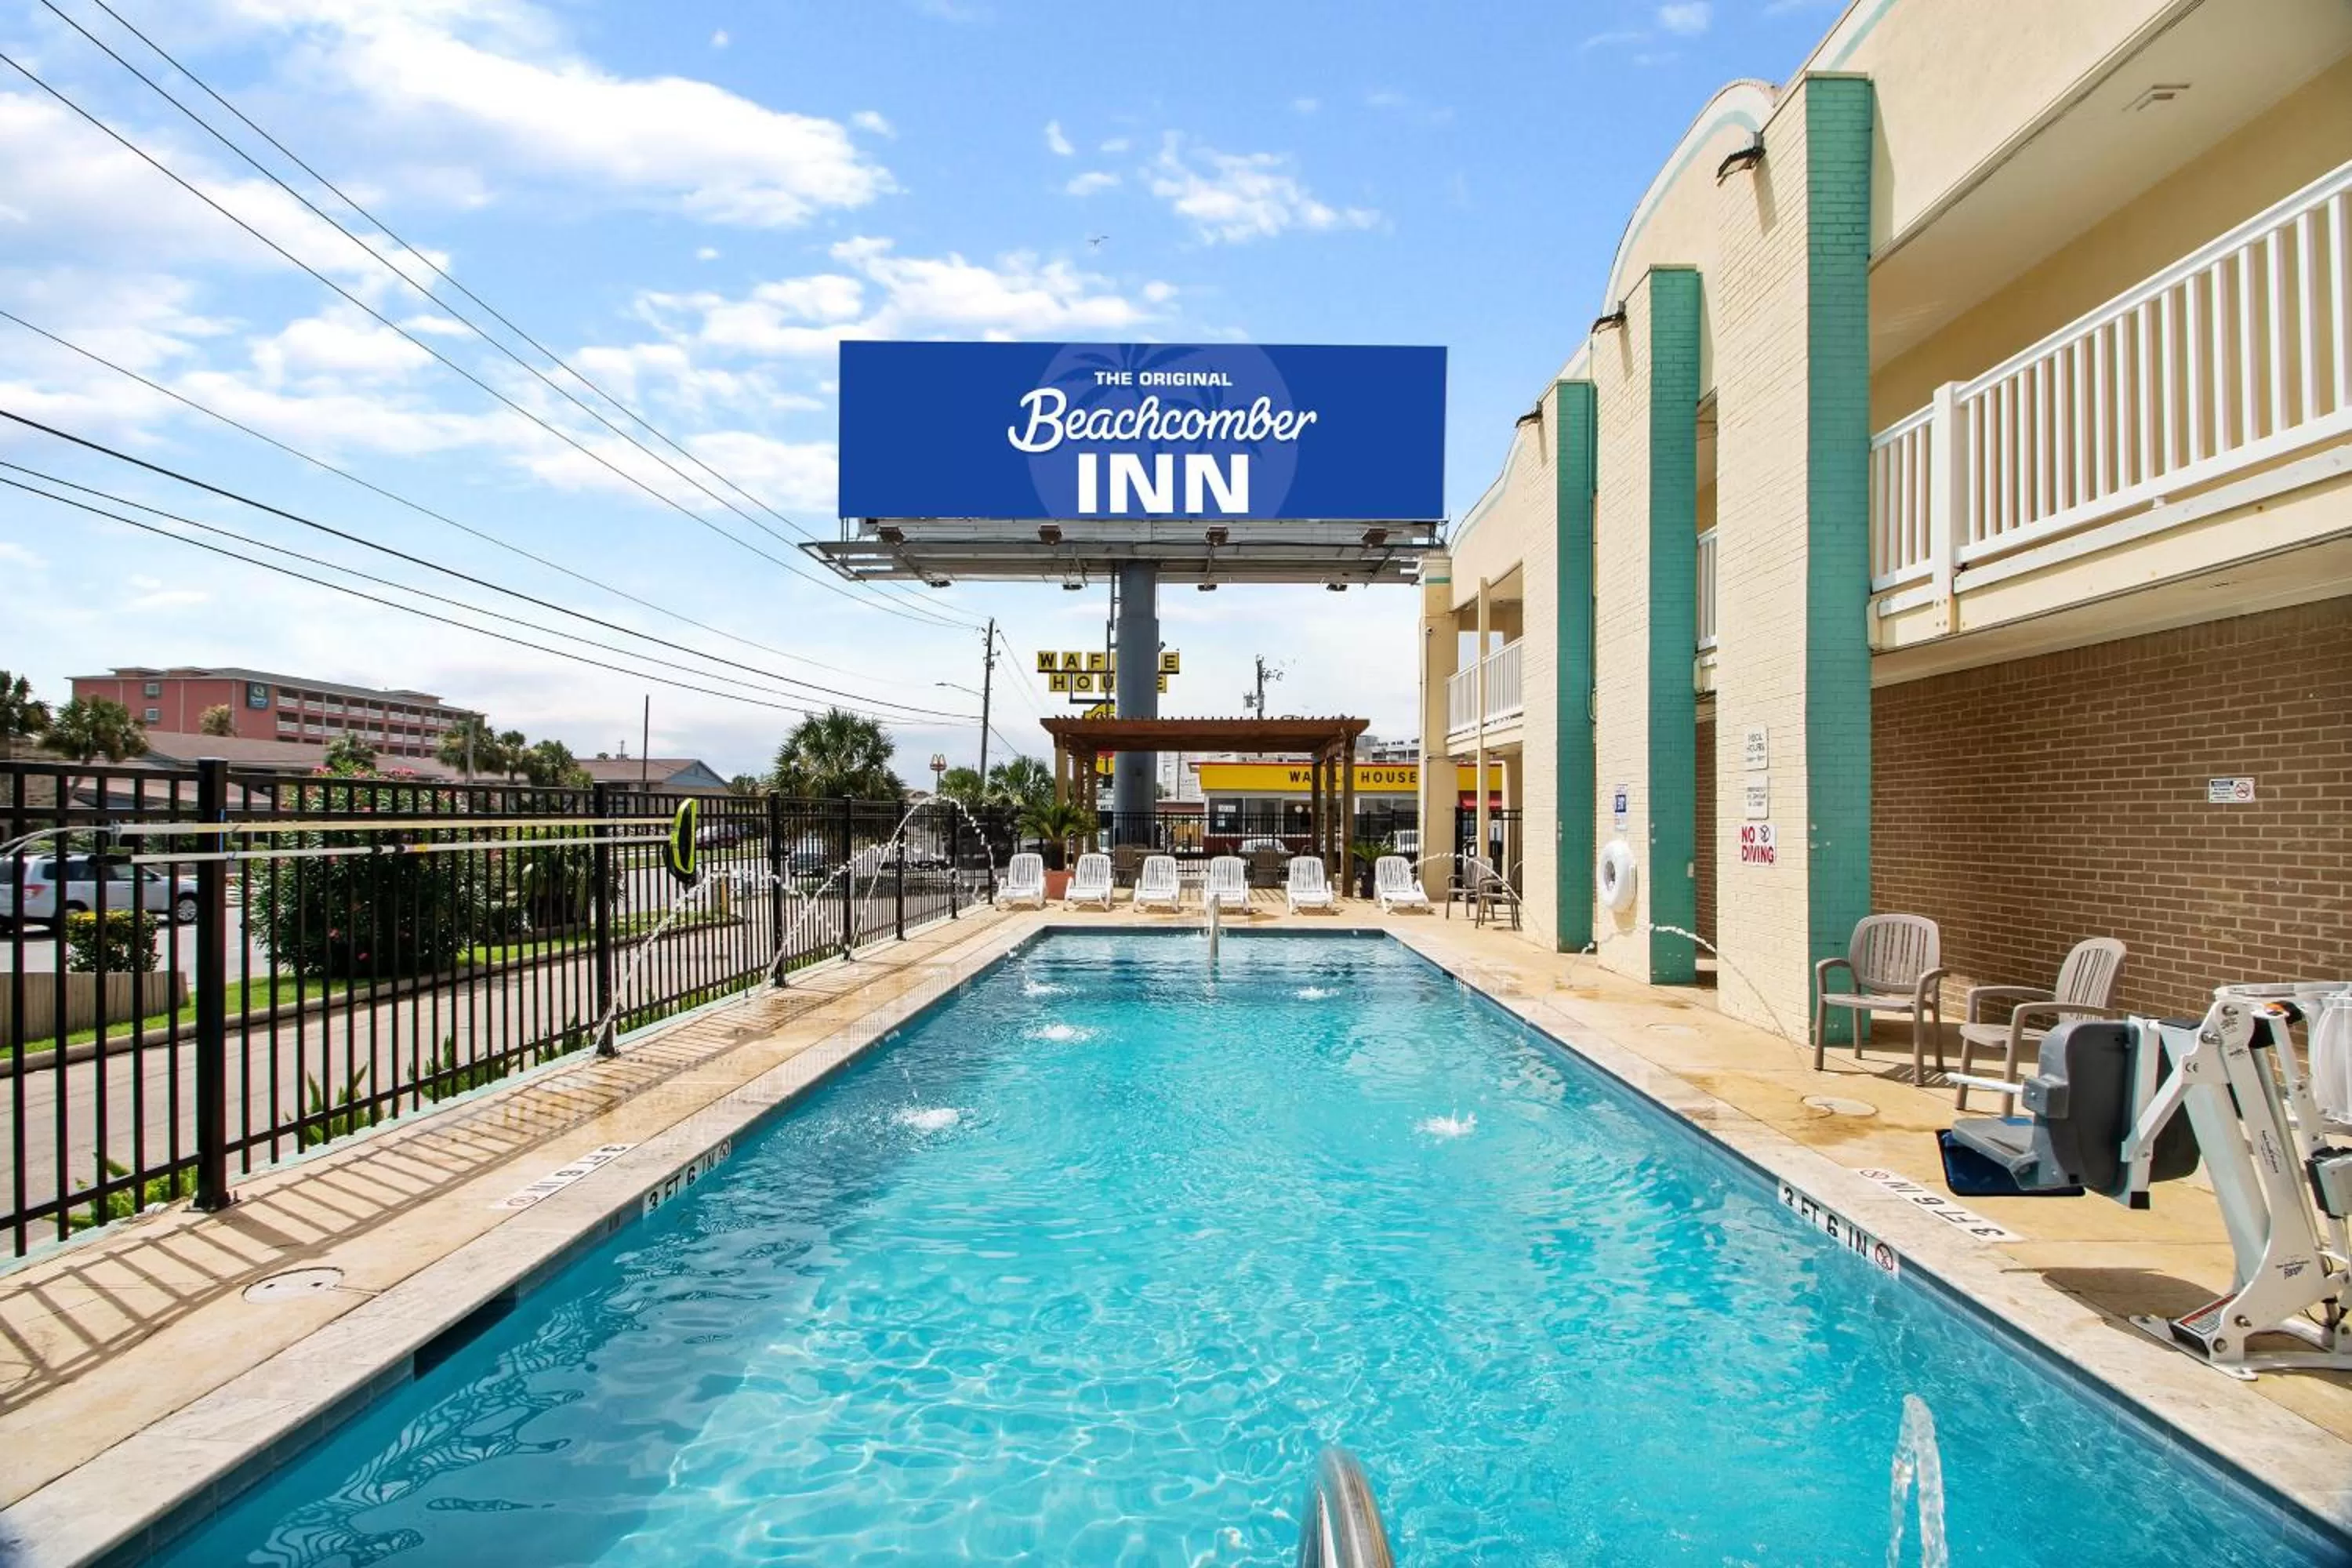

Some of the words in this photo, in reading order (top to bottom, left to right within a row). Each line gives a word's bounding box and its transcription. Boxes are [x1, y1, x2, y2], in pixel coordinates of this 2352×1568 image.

[1094, 372, 1133, 385] THE
[1139, 372, 1232, 387] ORIGINAL
[1007, 387, 1318, 452] Beachcomber
[1078, 452, 1249, 514] INN
[1040, 653, 1176, 669] WAFE
[1053, 675, 1163, 690] HOUE
[1361, 771, 1417, 783] HOUSE
[1741, 826, 1755, 844] NO
[1741, 845, 1774, 863] DIVING
[649, 1192, 658, 1212] 3
[664, 1174, 681, 1201] FT
[1883, 1181, 1923, 1192] IN
[1784, 1187, 1793, 1207] 3
[1801, 1196, 1820, 1223] FT
[1827, 1214, 1838, 1238] 6
[1849, 1225, 1867, 1258] IN
[1933, 1210, 1982, 1223] FT
[1970, 1227, 2005, 1236] 3
